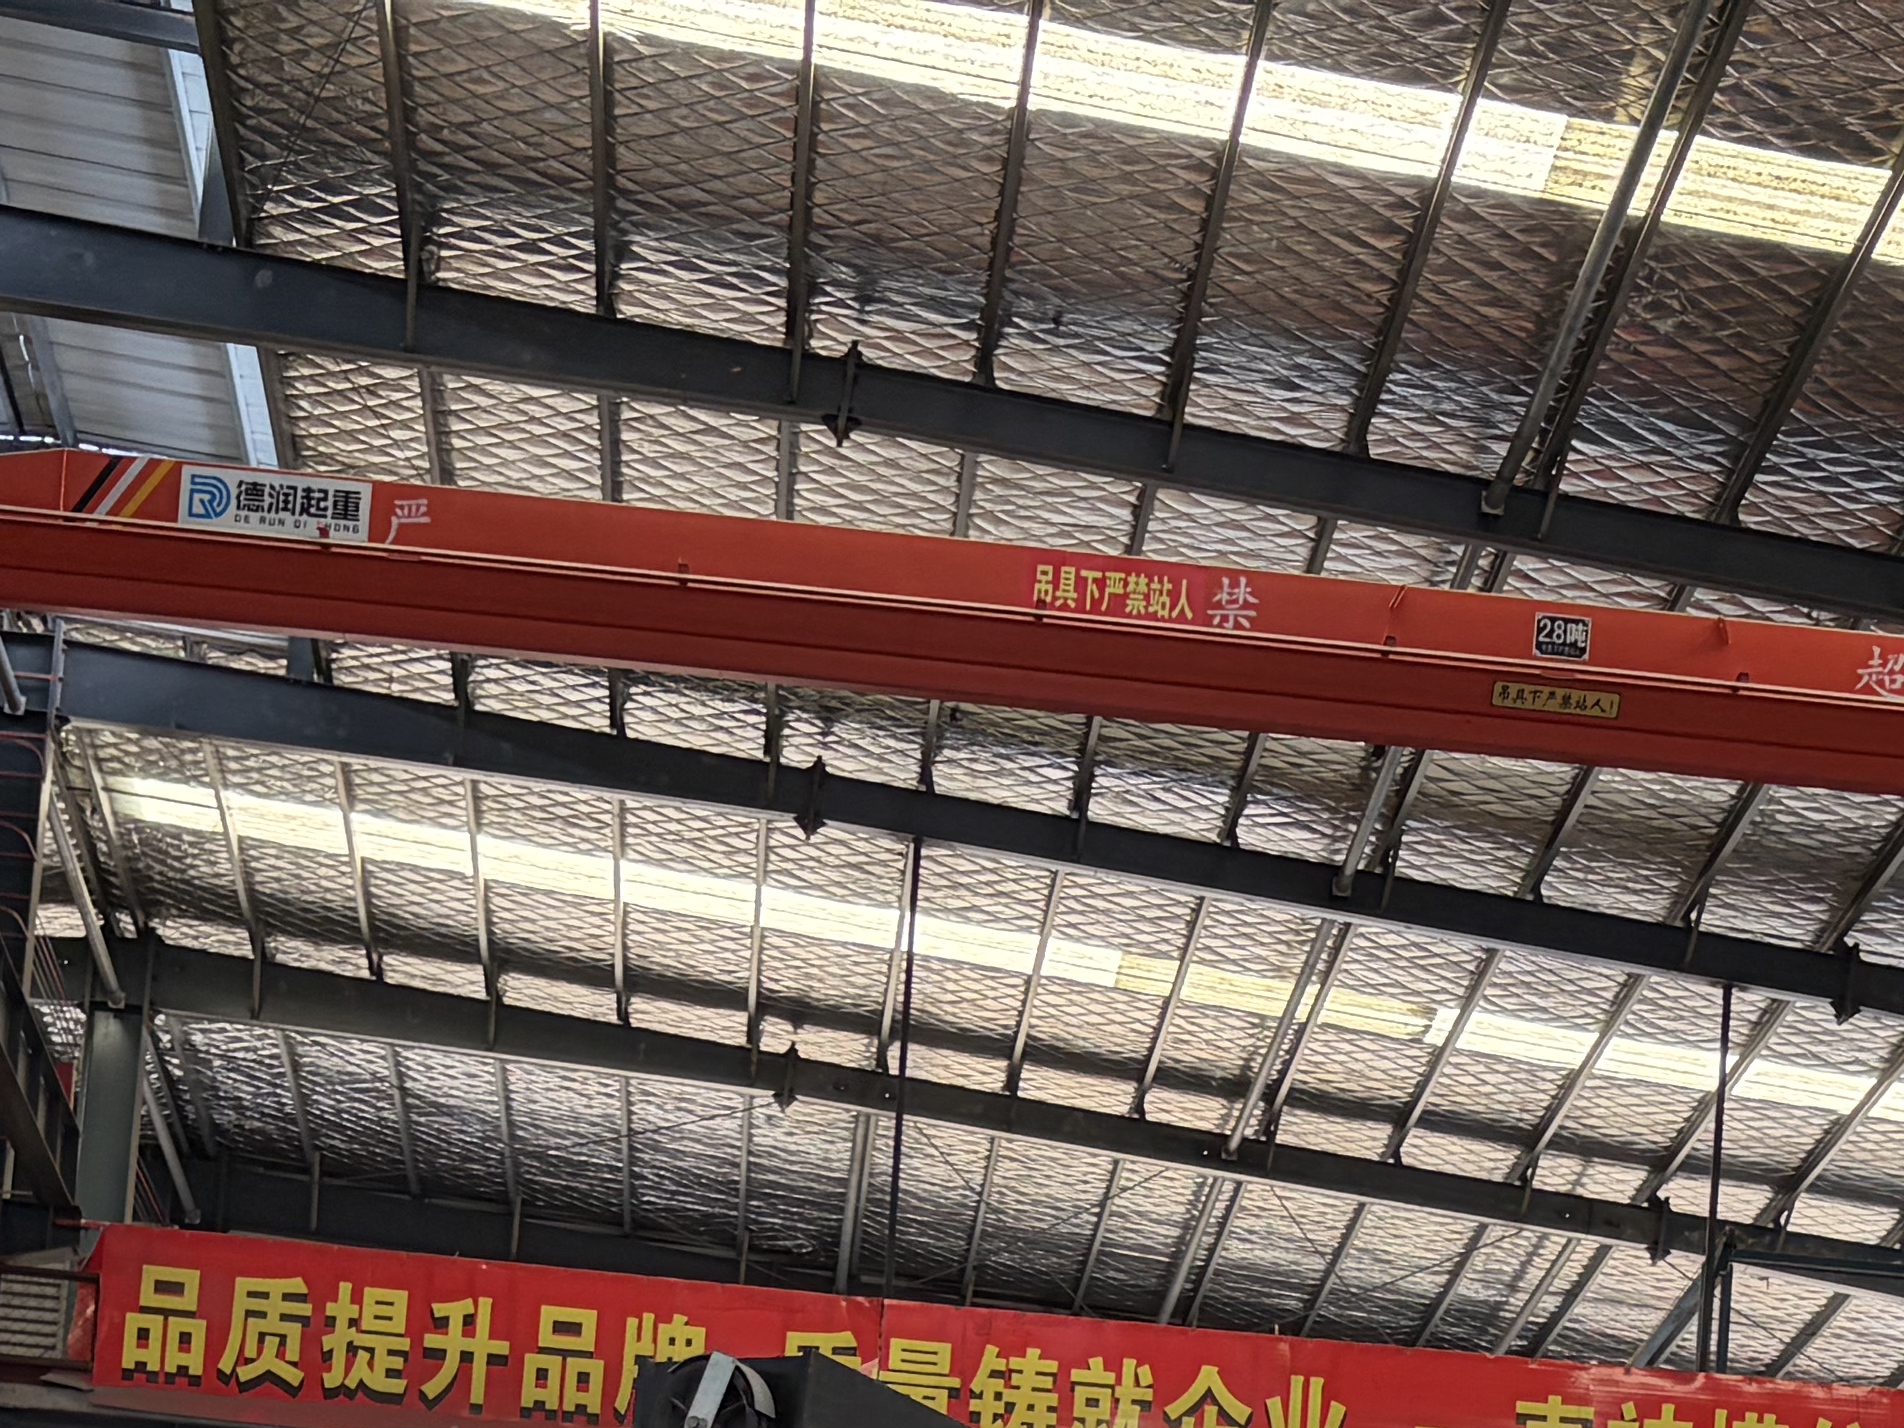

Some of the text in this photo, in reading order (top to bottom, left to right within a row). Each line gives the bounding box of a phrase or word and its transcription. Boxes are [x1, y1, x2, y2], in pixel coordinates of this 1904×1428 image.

[235, 479, 362, 522] 德润起重
[318, 520, 360, 534] HONG
[384, 498, 432, 545] 严
[1206, 576, 1260, 630] 禁
[1032, 563, 1194, 621] 吊具下严禁站人
[1538, 618, 1587, 648] 28吨
